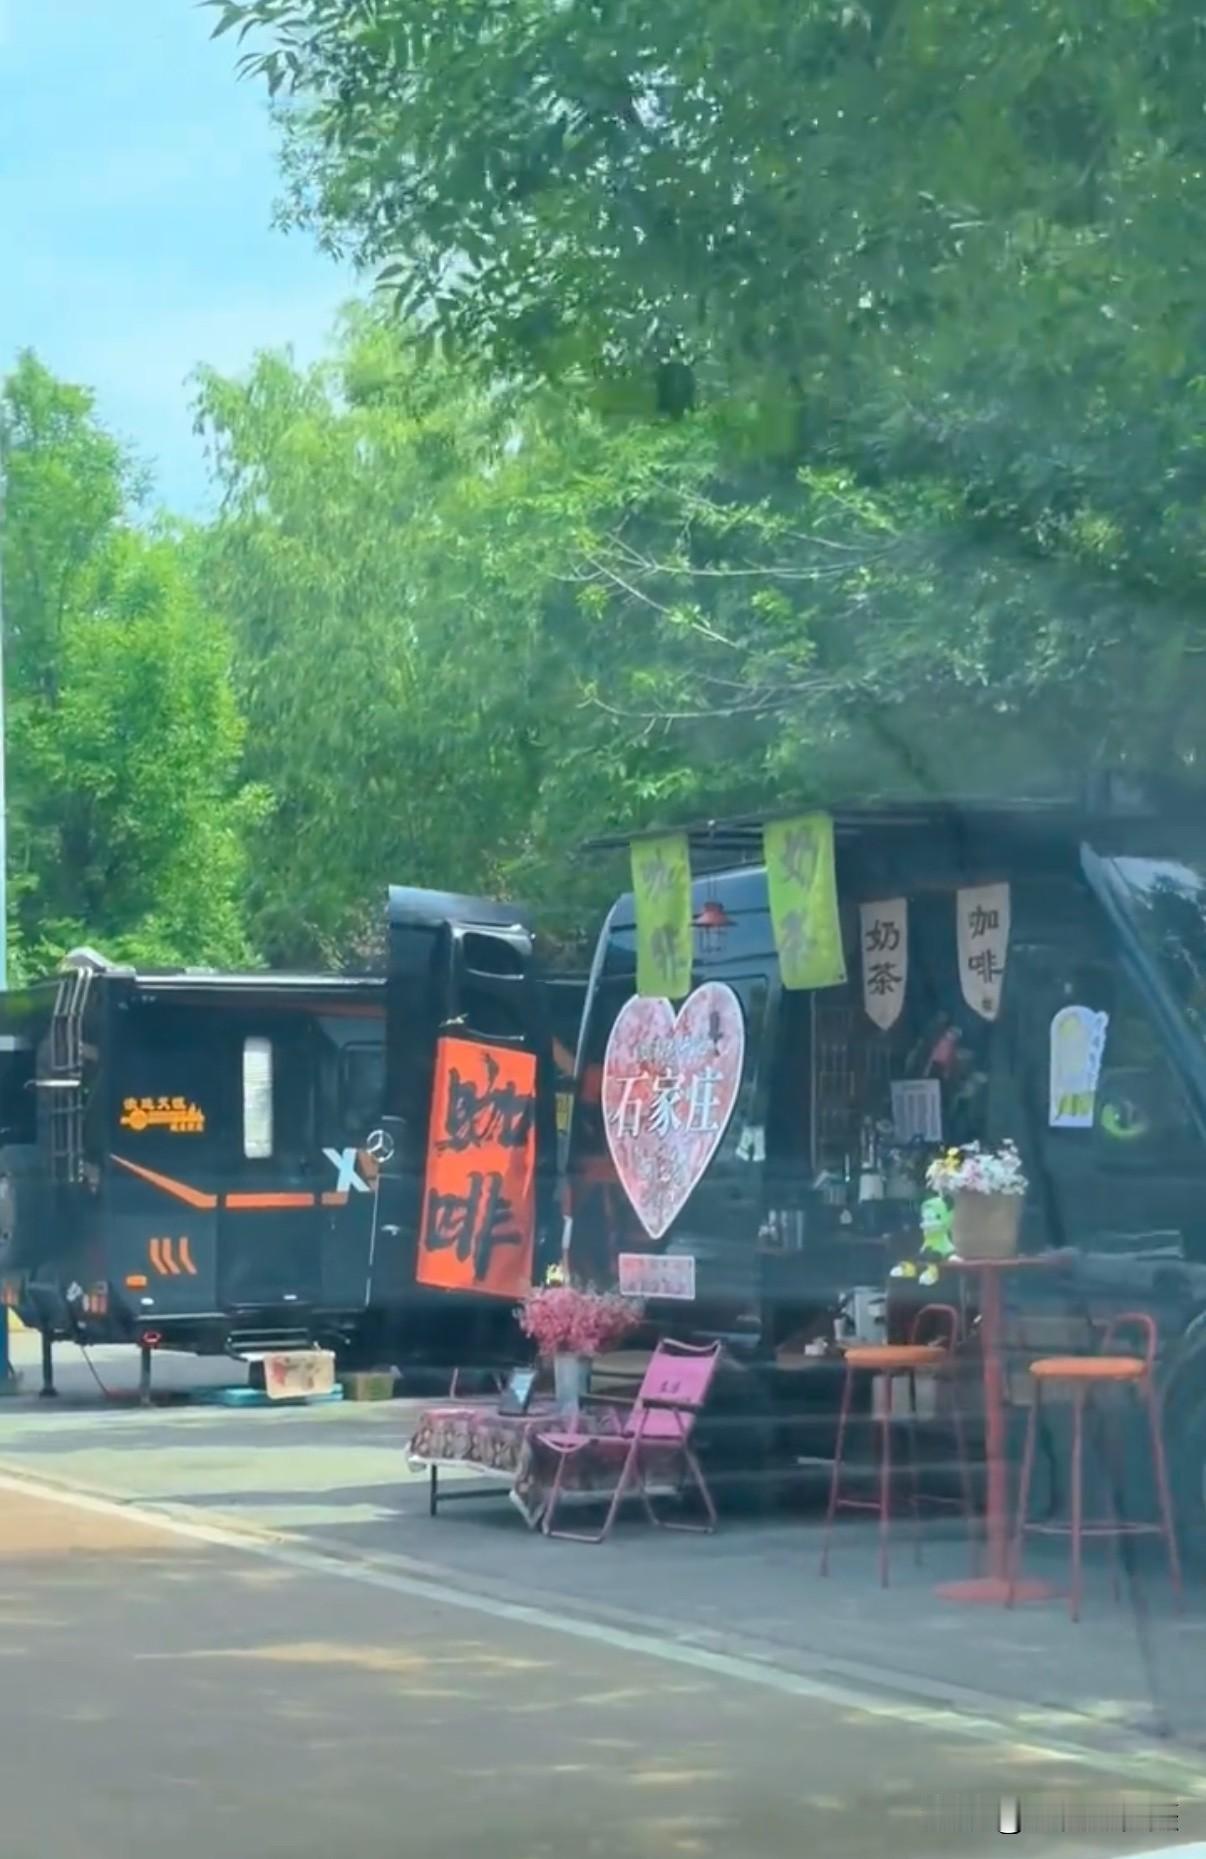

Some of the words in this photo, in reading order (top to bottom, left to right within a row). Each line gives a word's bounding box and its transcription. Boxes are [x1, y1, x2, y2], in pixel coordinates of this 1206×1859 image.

[865, 919, 902, 996] 奶茶
[609, 1065, 724, 1138] 石家庄
[426, 1052, 536, 1282] 咖啡
